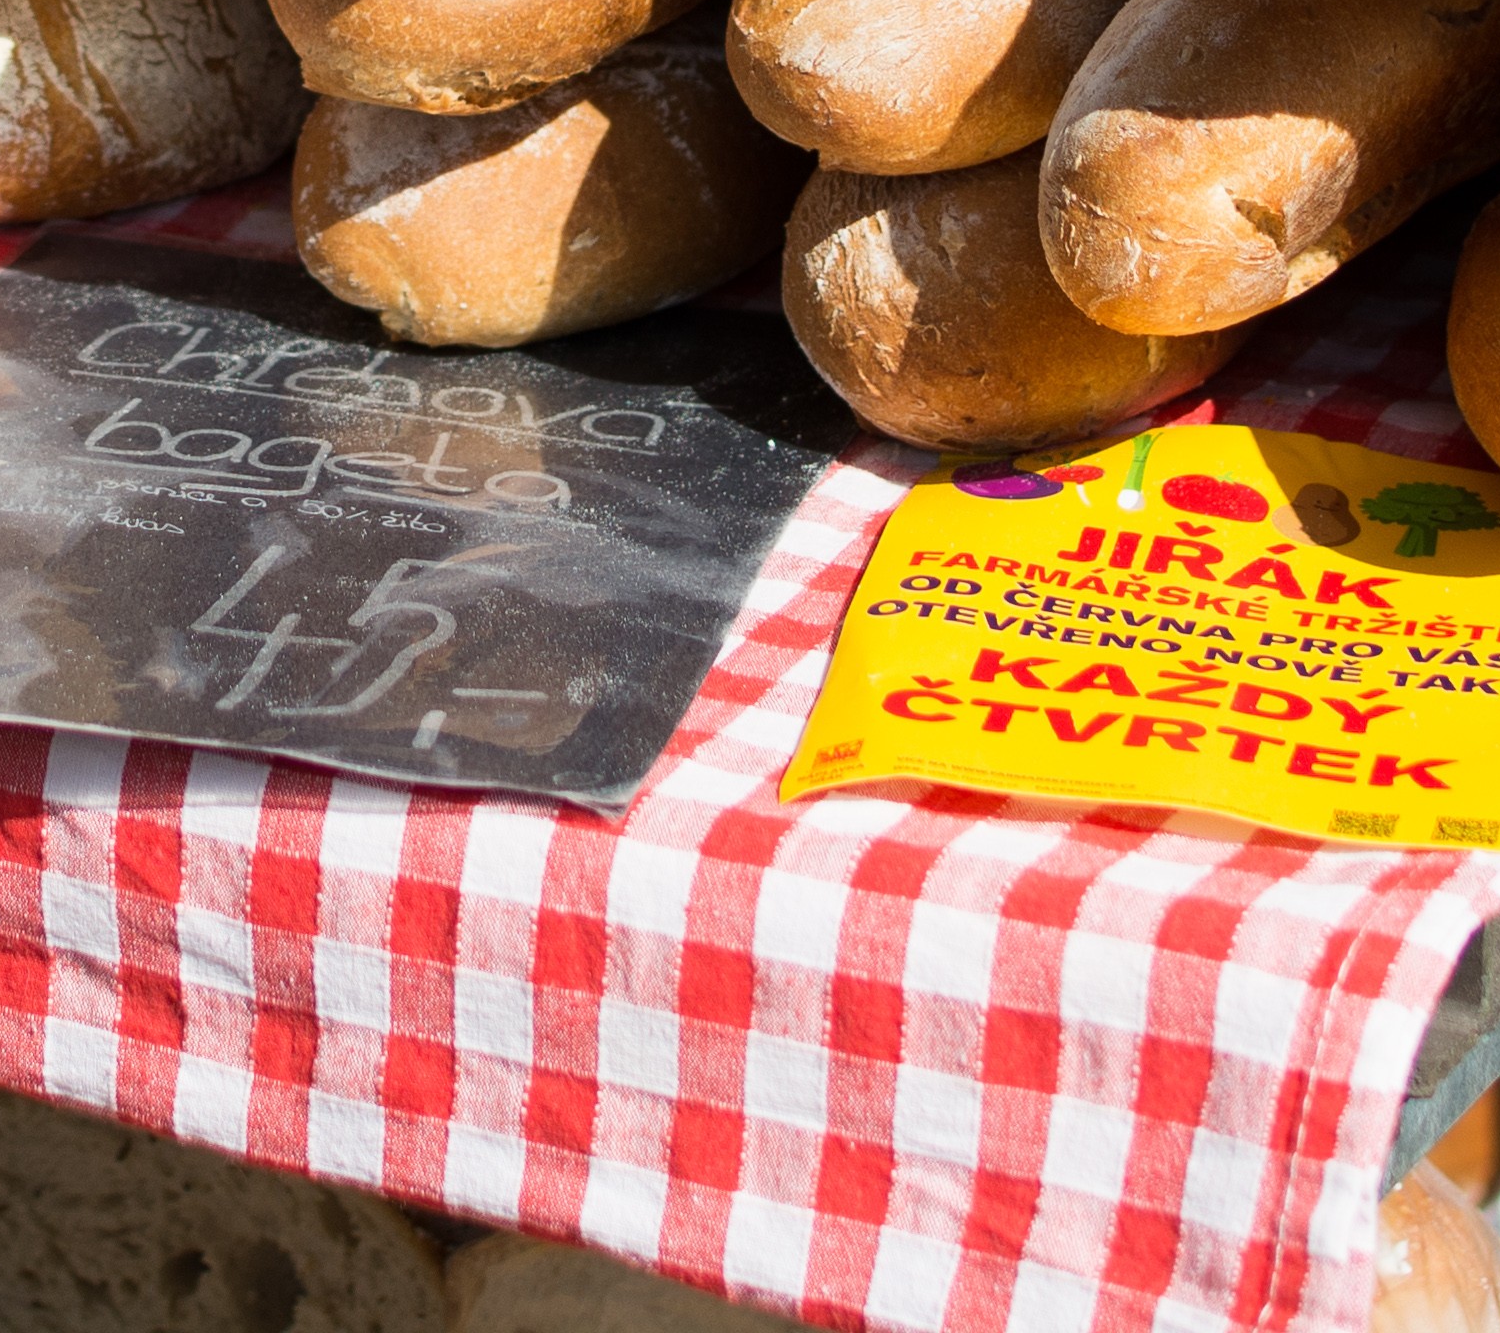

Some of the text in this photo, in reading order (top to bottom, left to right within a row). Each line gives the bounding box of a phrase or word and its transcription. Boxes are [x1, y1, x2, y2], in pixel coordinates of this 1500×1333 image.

[84, 397, 573, 509] bageta
[241, 496, 268, 508] a
[296, 498, 371, 522] 50%
[908, 550, 1269, 622] FARMÁŘSKÉ
[1057, 520, 1402, 610] JIŘÁK
[866, 599, 1182, 653] OTEVŘENO
[1203, 646, 1364, 683] NOVĚ
[899, 574, 983, 596] OD
[1003, 581, 1236, 641] ČERVNA
[1258, 632, 1384, 659] PRO
[881, 674, 1459, 791] ČTVRTEK
[969, 647, 1405, 734] KAŽDÝ
